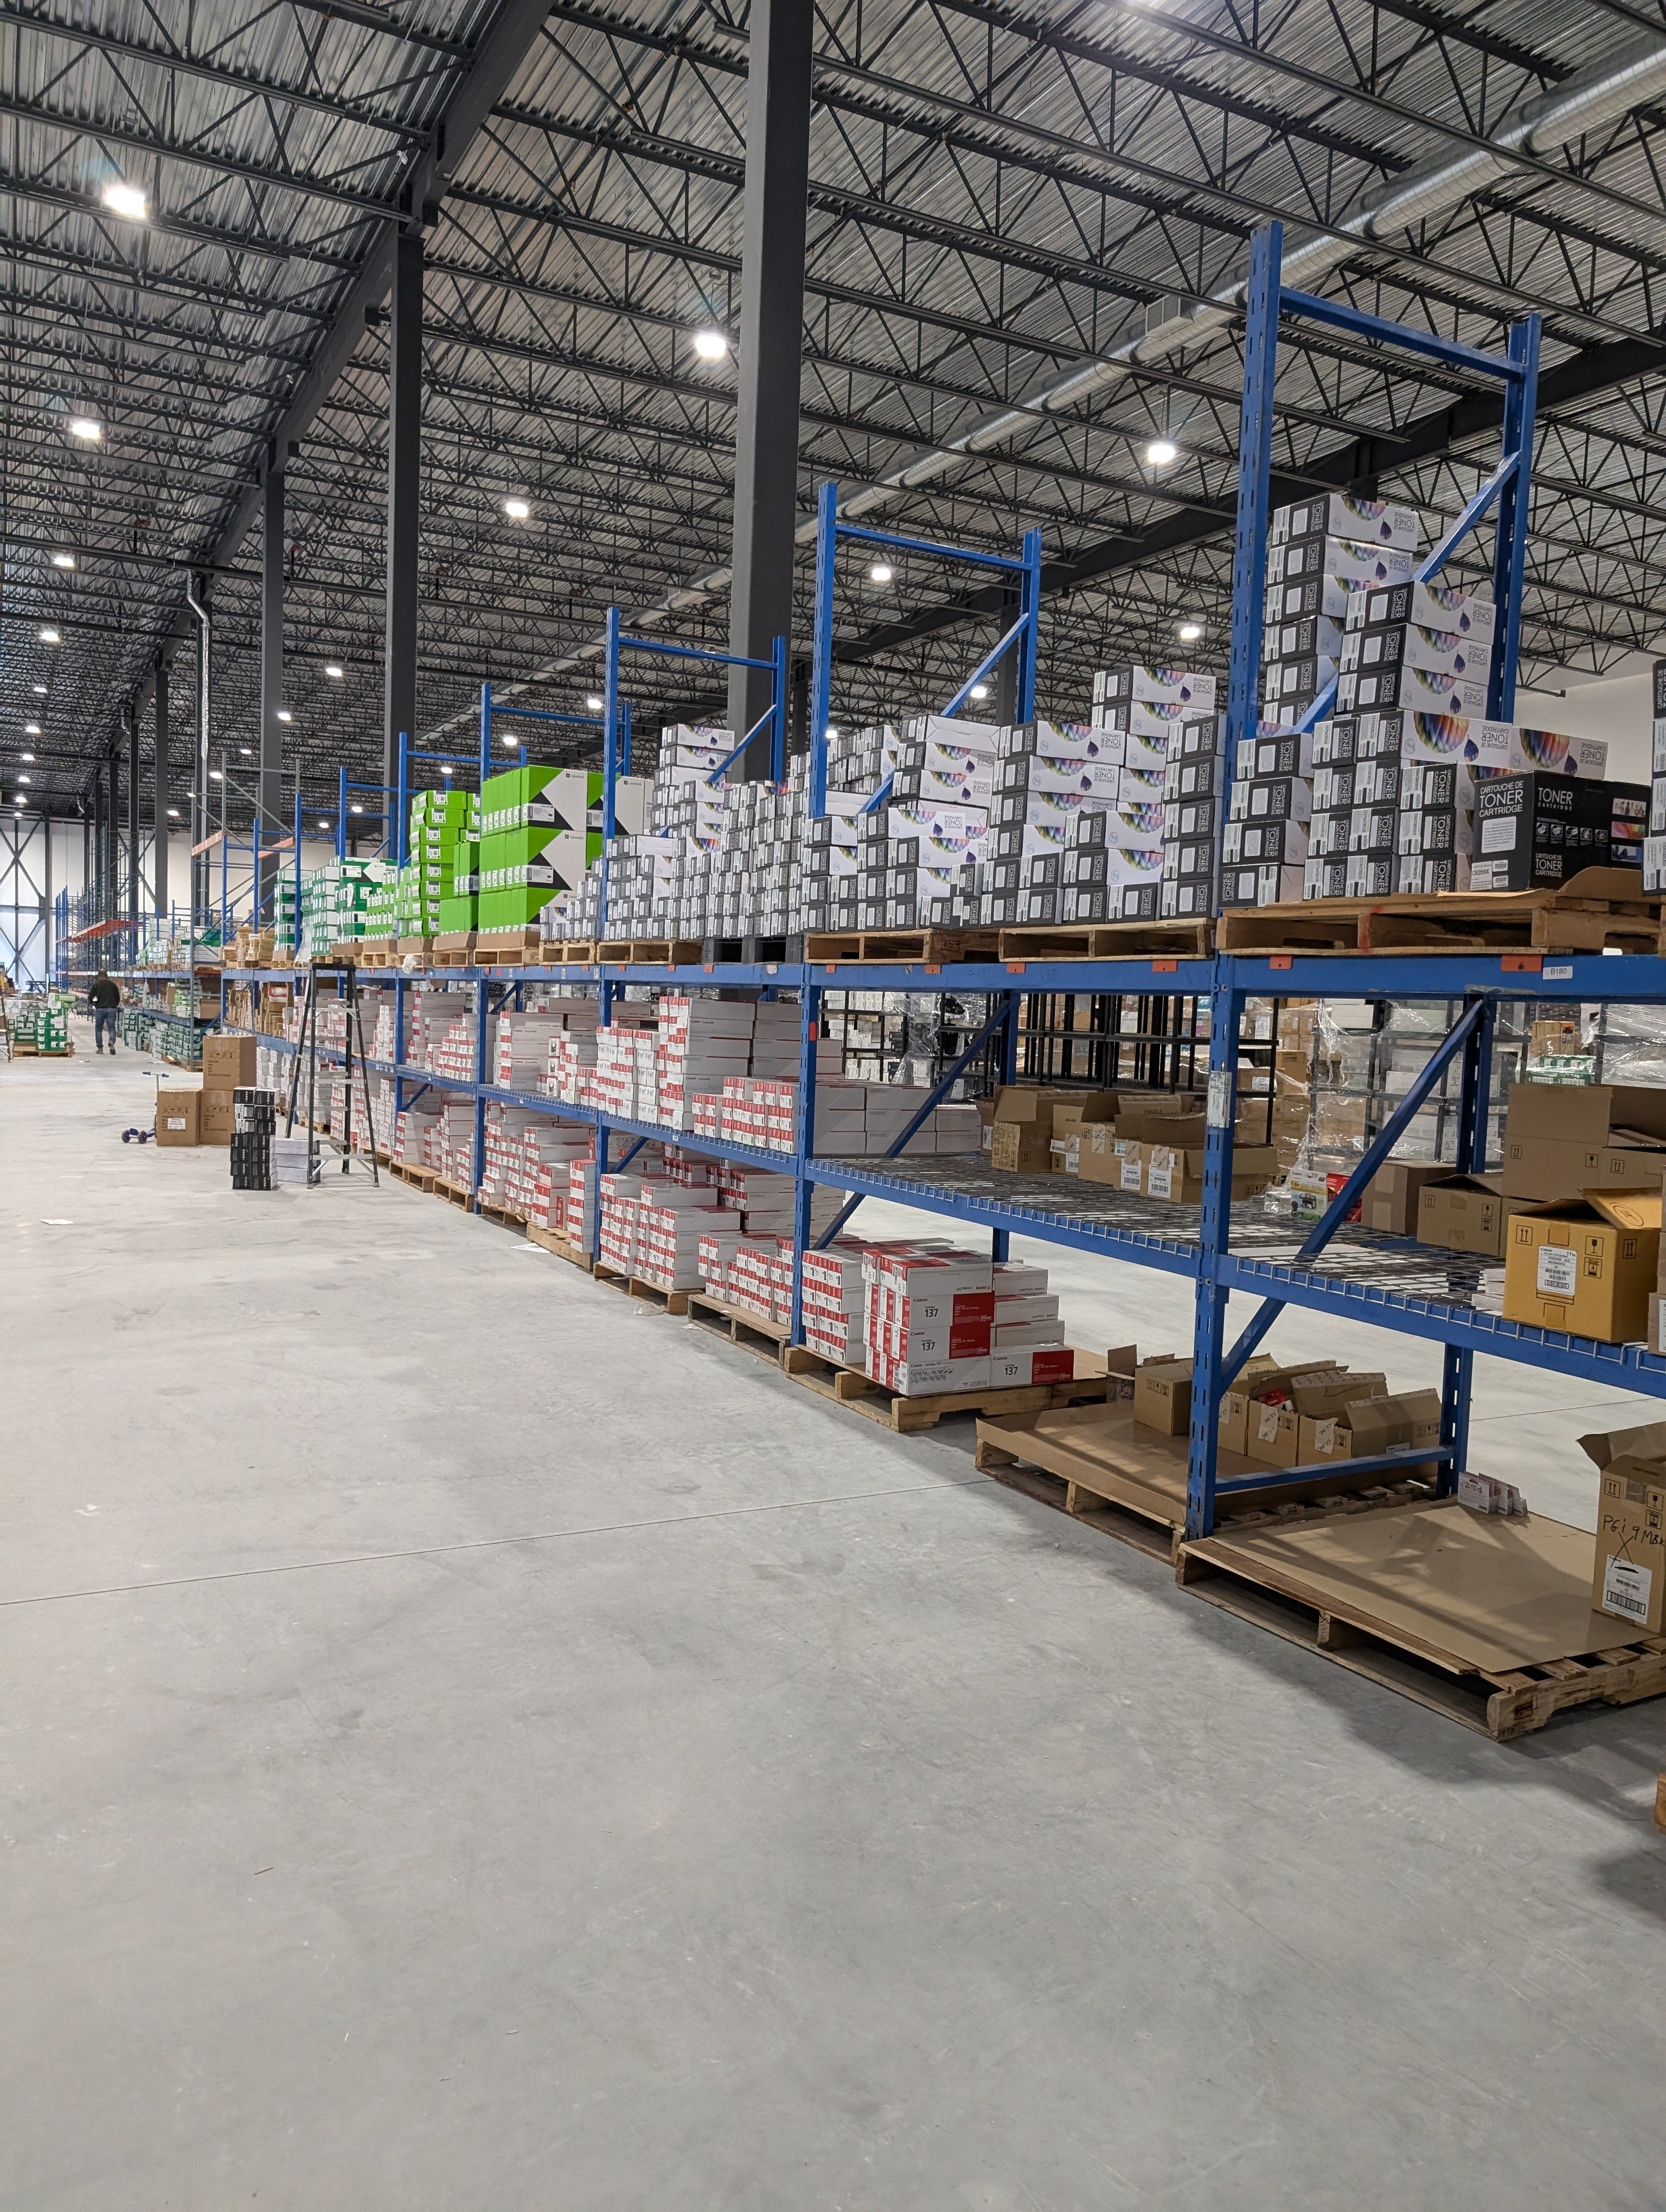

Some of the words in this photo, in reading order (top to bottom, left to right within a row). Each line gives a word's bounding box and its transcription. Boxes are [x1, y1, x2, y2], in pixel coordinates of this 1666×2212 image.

[1313, 503, 1322, 531] TONER
[1394, 517, 1415, 528] TONER
[1389, 557, 1409, 568] TONER
[1394, 589, 1404, 618] TONER
[1472, 609, 1492, 621] TONER
[1388, 632, 1396, 661] TONER
[1468, 651, 1488, 661] TONER
[1383, 674, 1392, 703] TONER
[1464, 691, 1484, 701] TONER
[1342, 726, 1350, 757] TONER
[1388, 719, 1396, 751] TONER
[1481, 732, 1508, 743] TONER
[1580, 748, 1605, 760] TONER
[1341, 773, 1349, 804] TONER
[1385, 767, 1394, 799] TONER
[1437, 770, 1447, 803] TONER
[1480, 783, 1514, 794] CARTOUCHE
[1479, 790, 1523, 808] TONER
[1539, 787, 1573, 805] TONER
[1479, 804, 1523, 817] CARTRIDGE
[1538, 802, 1572, 811] CARTRIDGE
[1338, 820, 1346, 851] TONER
[1380, 815, 1389, 847] TONER
[1437, 815, 1446, 848] TONER
[1535, 859, 1562, 870] TONER
[1377, 862, 1386, 893] TONER
[1535, 869, 1562, 878] CARTRIDGE
[925, 1309, 939, 1318] 137
[922, 1342, 935, 1351] 137
[1004, 1367, 1018, 1375] 137
[1632, 1526, 1640, 1540] 9
